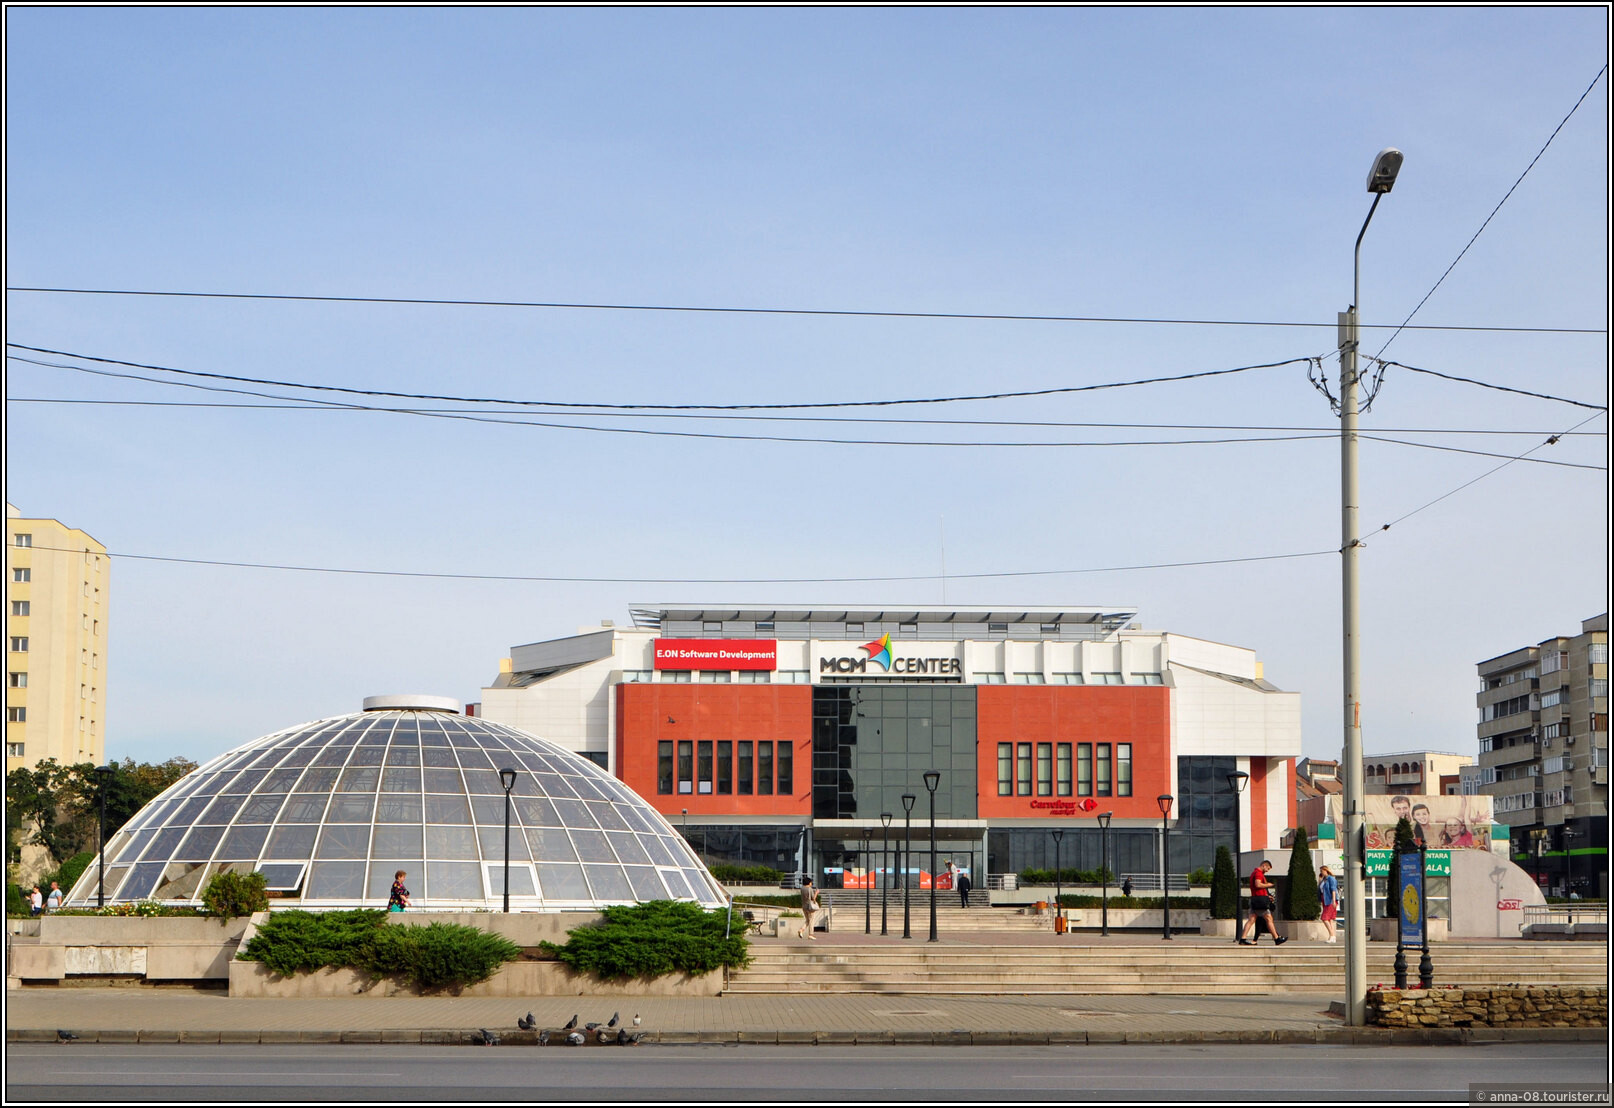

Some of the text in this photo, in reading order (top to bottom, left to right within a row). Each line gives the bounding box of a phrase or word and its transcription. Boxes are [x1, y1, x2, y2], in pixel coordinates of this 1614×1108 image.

[656, 649, 775, 660] E.ON Software Development
[820, 656, 962, 673] MCM CENTER
[1030, 799, 1076, 809] Carrefour
